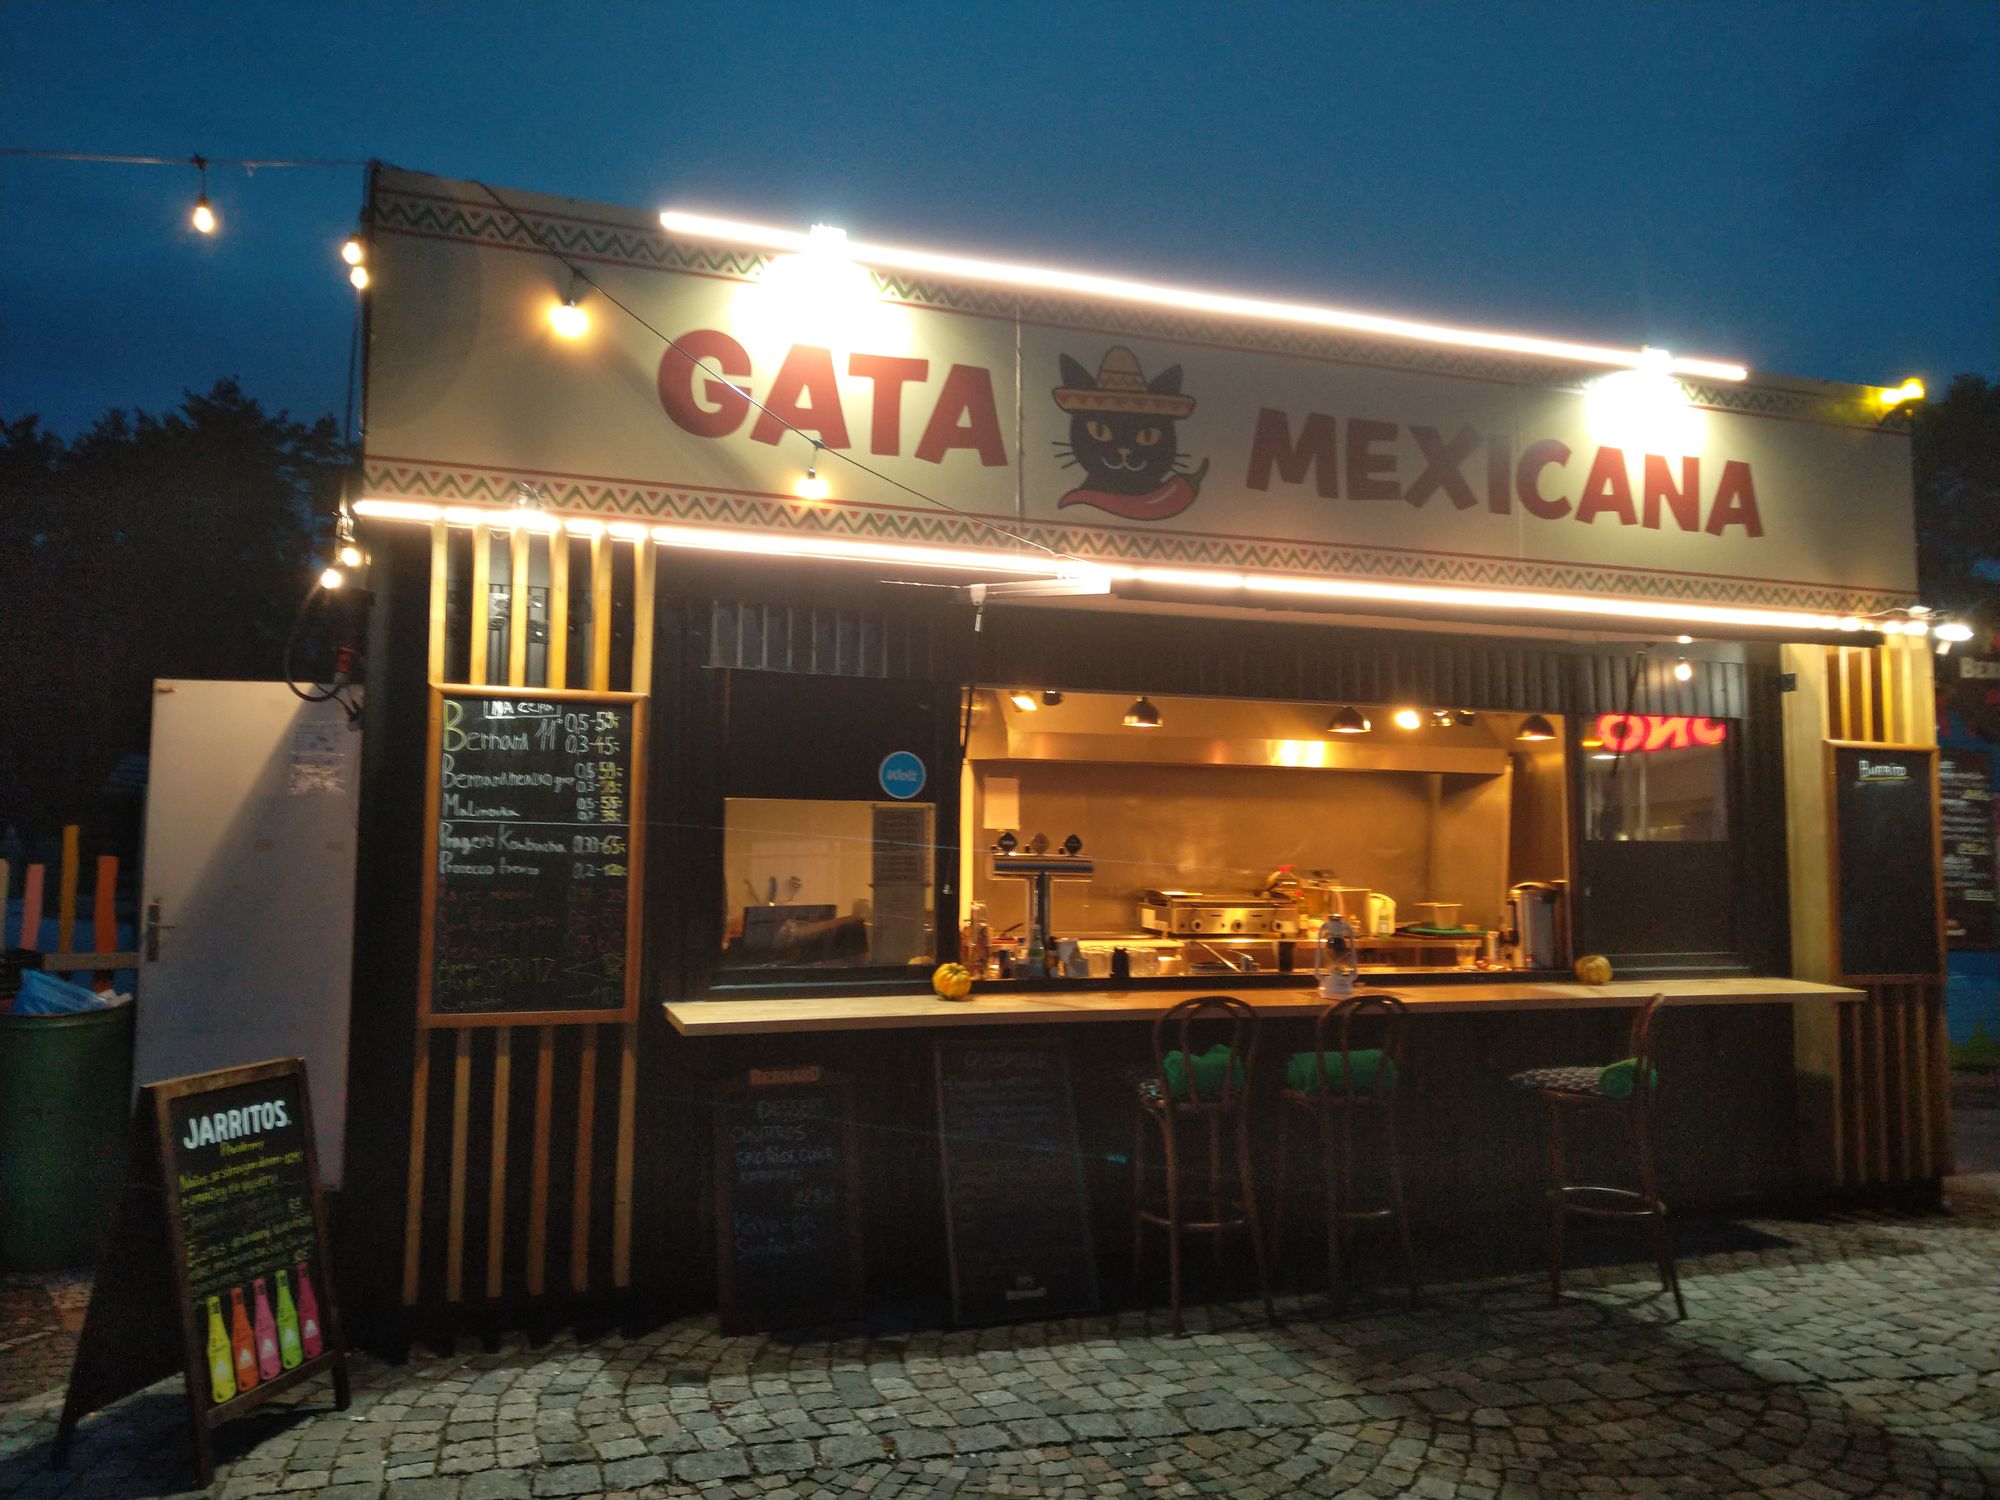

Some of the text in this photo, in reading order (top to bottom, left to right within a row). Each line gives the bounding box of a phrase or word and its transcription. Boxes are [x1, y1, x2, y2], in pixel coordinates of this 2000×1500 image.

[658, 328, 1764, 538] GATA MEXICANA
[442, 700, 529, 752] Bernard
[183, 1100, 291, 1150] JARRITOS
